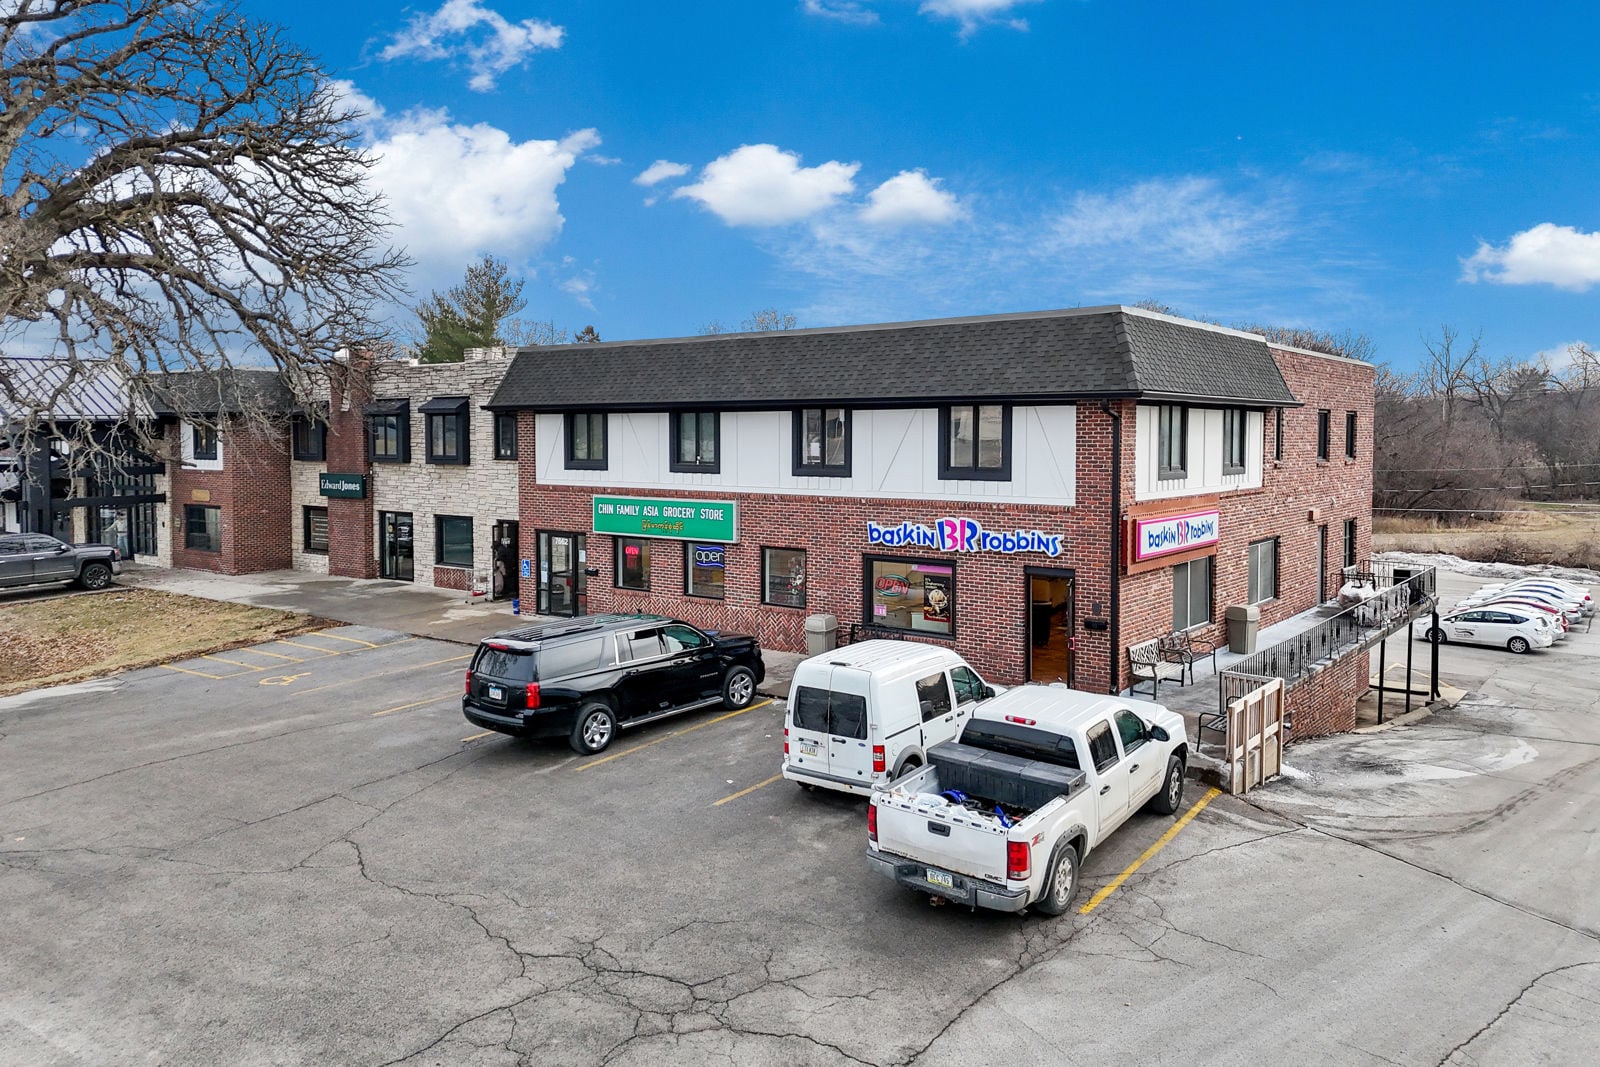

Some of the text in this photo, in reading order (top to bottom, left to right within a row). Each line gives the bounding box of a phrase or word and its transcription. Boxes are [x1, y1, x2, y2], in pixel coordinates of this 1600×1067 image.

[321, 479, 361, 491] Edward Jones
[598, 503, 724, 521] CHIN FAMILY ASIA GROCERY STORE
[867, 519, 1061, 556] baskin BR robbins
[1148, 525, 1176, 548] baskin
[1190, 520, 1214, 540] robbins
[625, 545, 640, 555] OPEN
[875, 576, 911, 591] OPEN
[984, 873, 1003, 883] GMC
